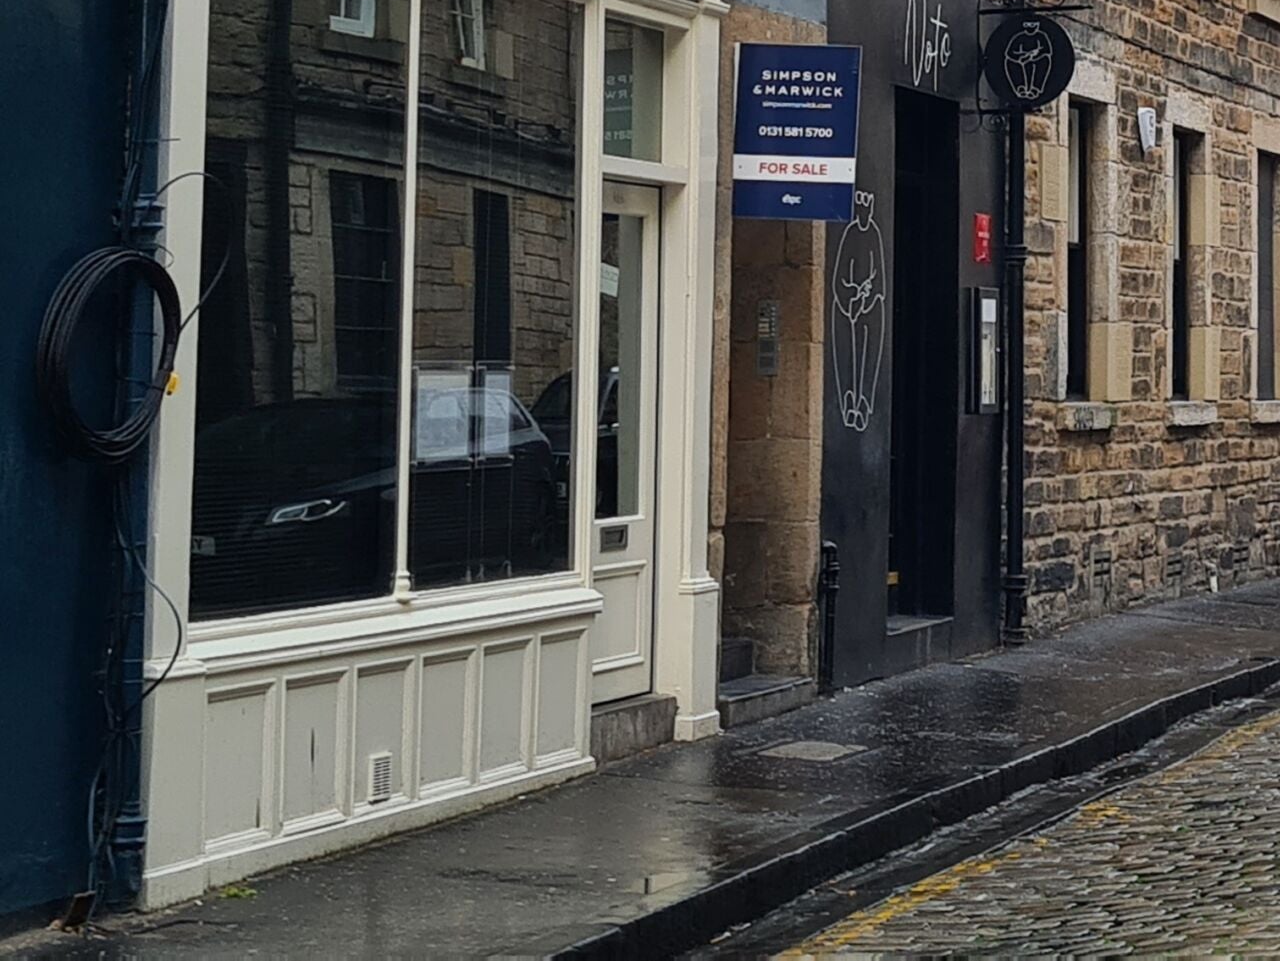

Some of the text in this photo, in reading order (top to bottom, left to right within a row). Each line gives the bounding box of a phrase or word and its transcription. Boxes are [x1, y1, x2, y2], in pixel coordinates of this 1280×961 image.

[762, 69, 837, 82] SIMPSON
[758, 126, 833, 138] 0131 581 5700
[759, 162, 828, 175] FOR SALE
